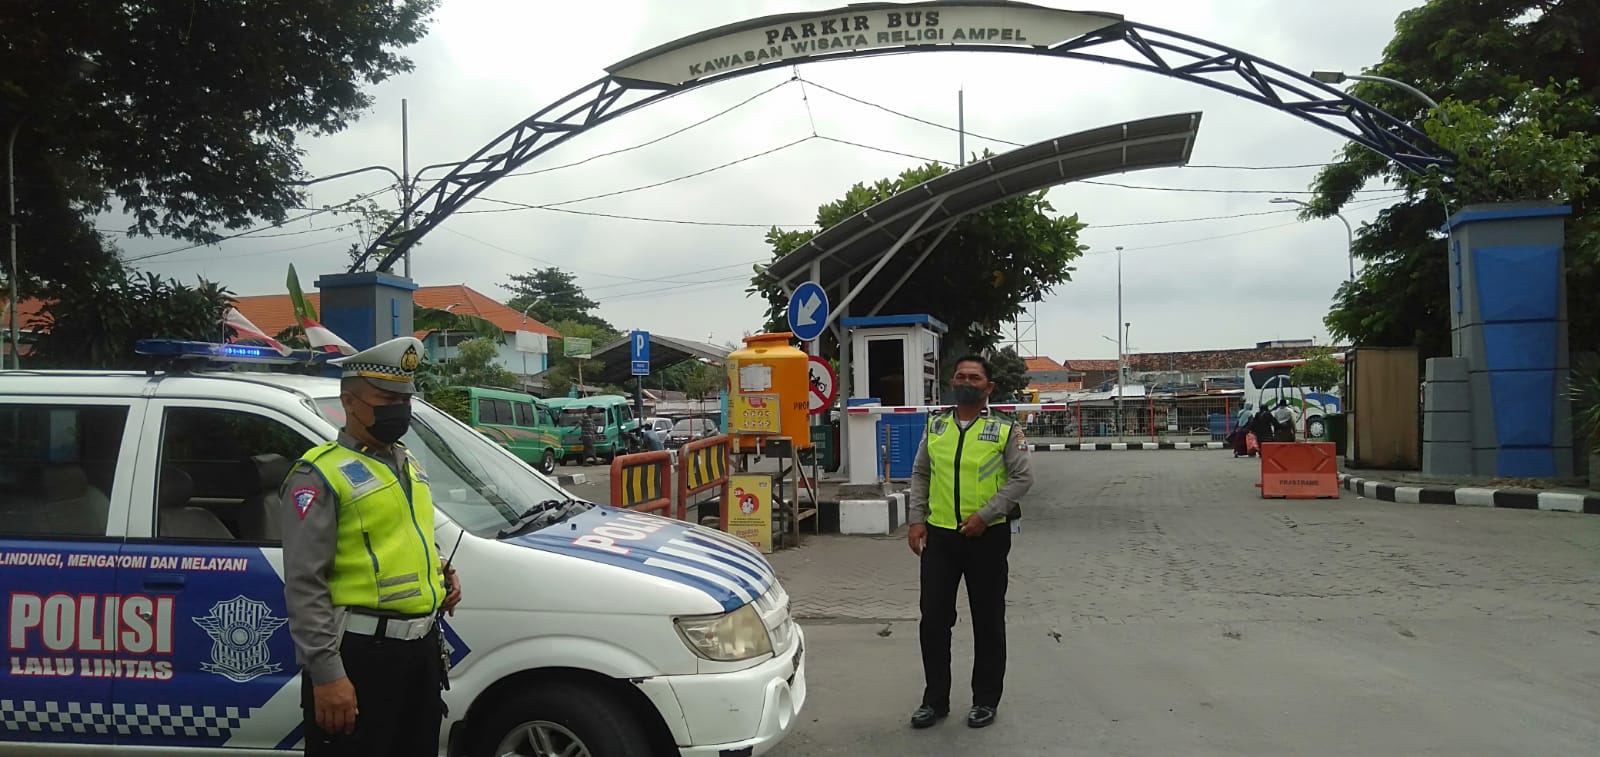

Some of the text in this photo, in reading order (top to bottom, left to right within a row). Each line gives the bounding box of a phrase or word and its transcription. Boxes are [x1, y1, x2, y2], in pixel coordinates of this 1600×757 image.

[765, 11, 940, 44] PARKIR BUS
[689, 28, 1027, 75] KAWASAN WISATA RELIGI AMPEL
[636, 334, 645, 357] P
[68, 554, 147, 569] MENGAYOMI
[150, 556, 178, 570] DAN
[180, 557, 248, 571] MELAYANI
[9, 592, 175, 655] POLISI
[10, 656, 174, 680] LALU LINTAS
